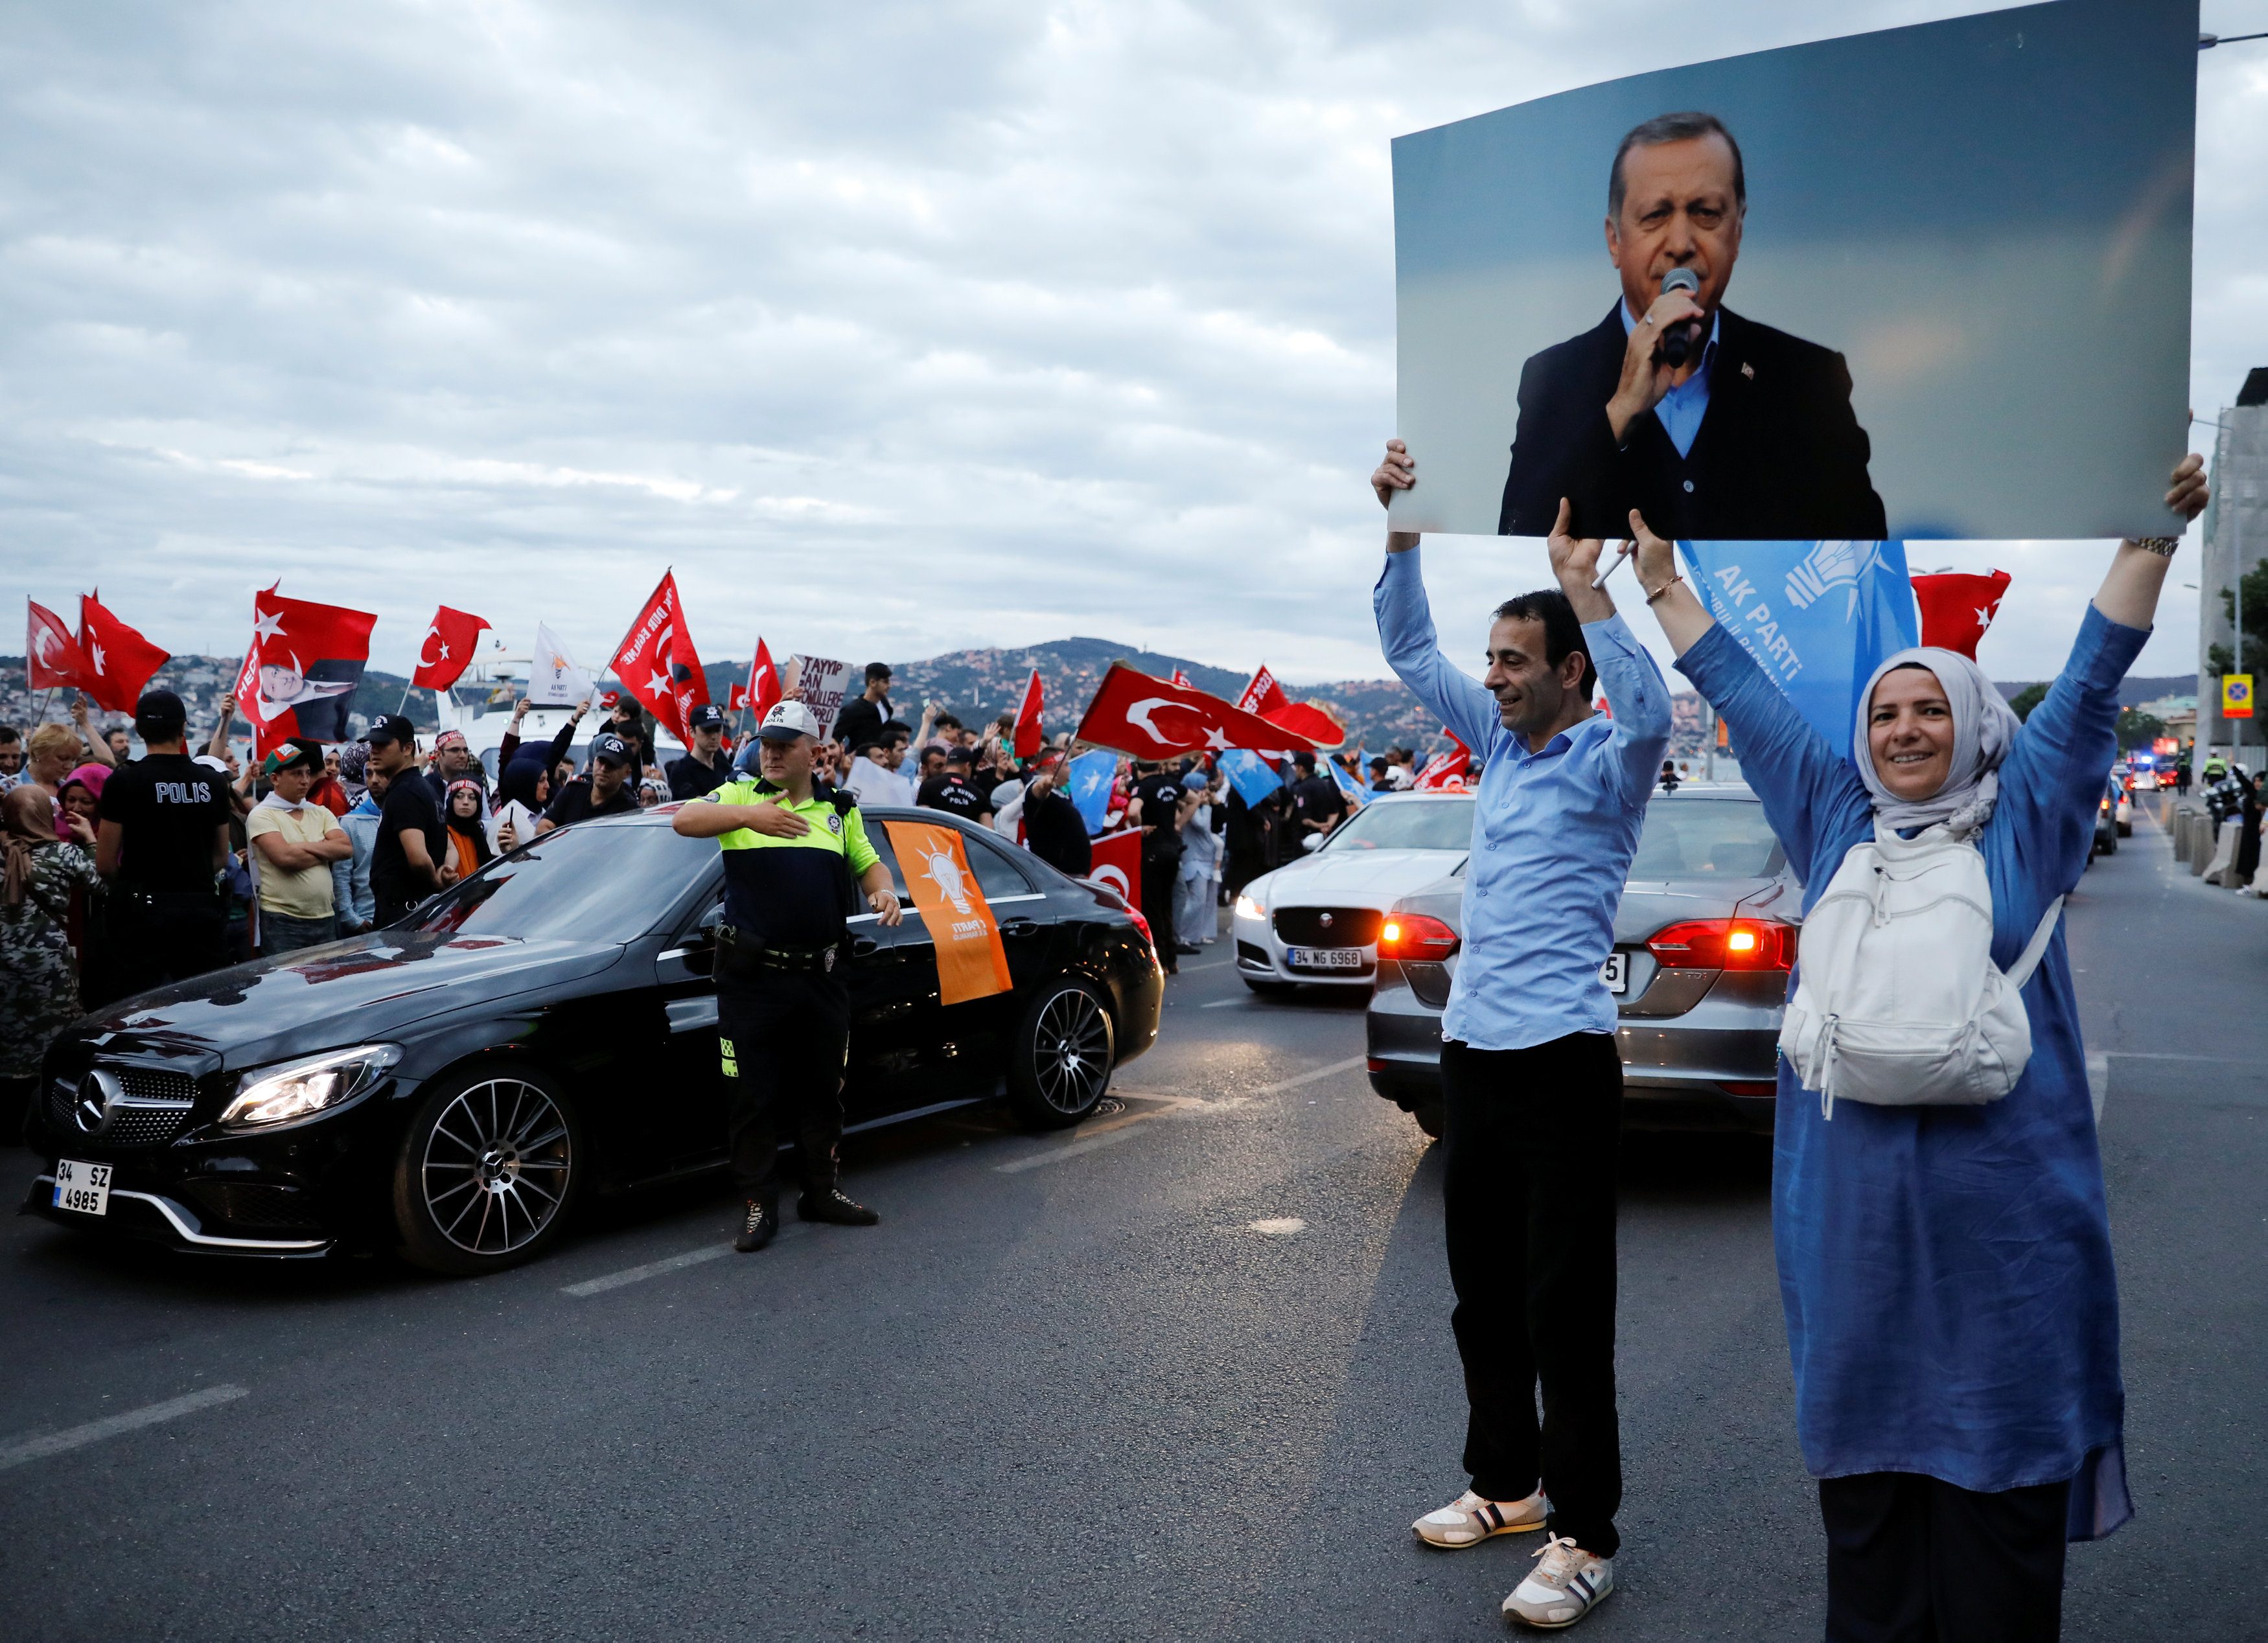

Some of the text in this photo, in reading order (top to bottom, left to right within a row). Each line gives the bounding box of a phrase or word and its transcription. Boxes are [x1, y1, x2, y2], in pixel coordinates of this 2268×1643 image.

[1713, 565, 1757, 608] AK
[1253, 672, 1273, 700] 2023
[156, 782, 211, 803] POLİS
[1296, 951, 1358, 965] 34 NG 6968
[58, 1162, 109, 1188] 34 SZ
[65, 1188, 99, 1212] 4985
